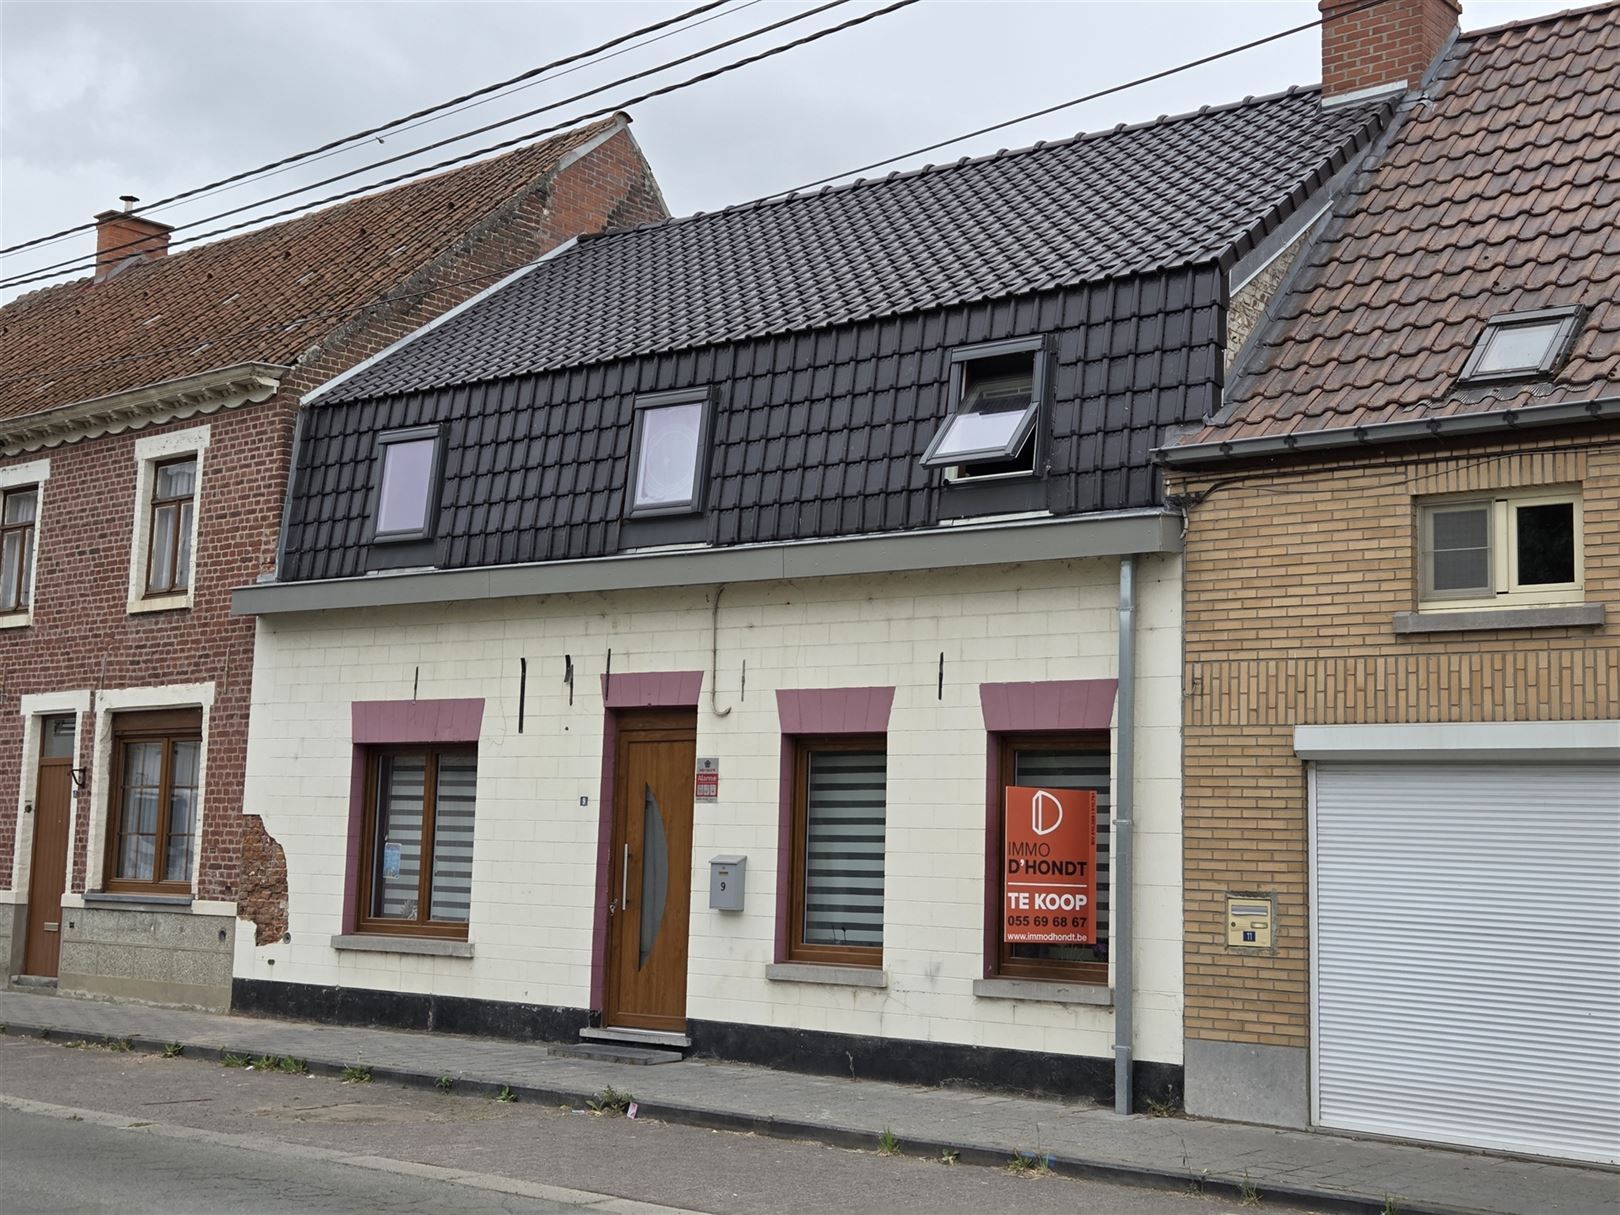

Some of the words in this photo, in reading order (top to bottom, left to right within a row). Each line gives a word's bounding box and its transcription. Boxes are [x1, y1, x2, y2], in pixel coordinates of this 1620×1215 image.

[1008, 842, 1050, 857] IMMO
[1008, 858, 1087, 876] D'HONDT
[720, 881, 726, 892] 9
[1008, 892, 1030, 909] TE
[1034, 893, 1087, 911] KOOP
[1008, 915, 1030, 927] 055
[1034, 916, 1048, 927] 69
[1052, 916, 1067, 927] 68
[1072, 917, 1087, 928] 67
[1008, 932, 1087, 942] www.immodhondt.be
[1246, 932, 1253, 941] 11
